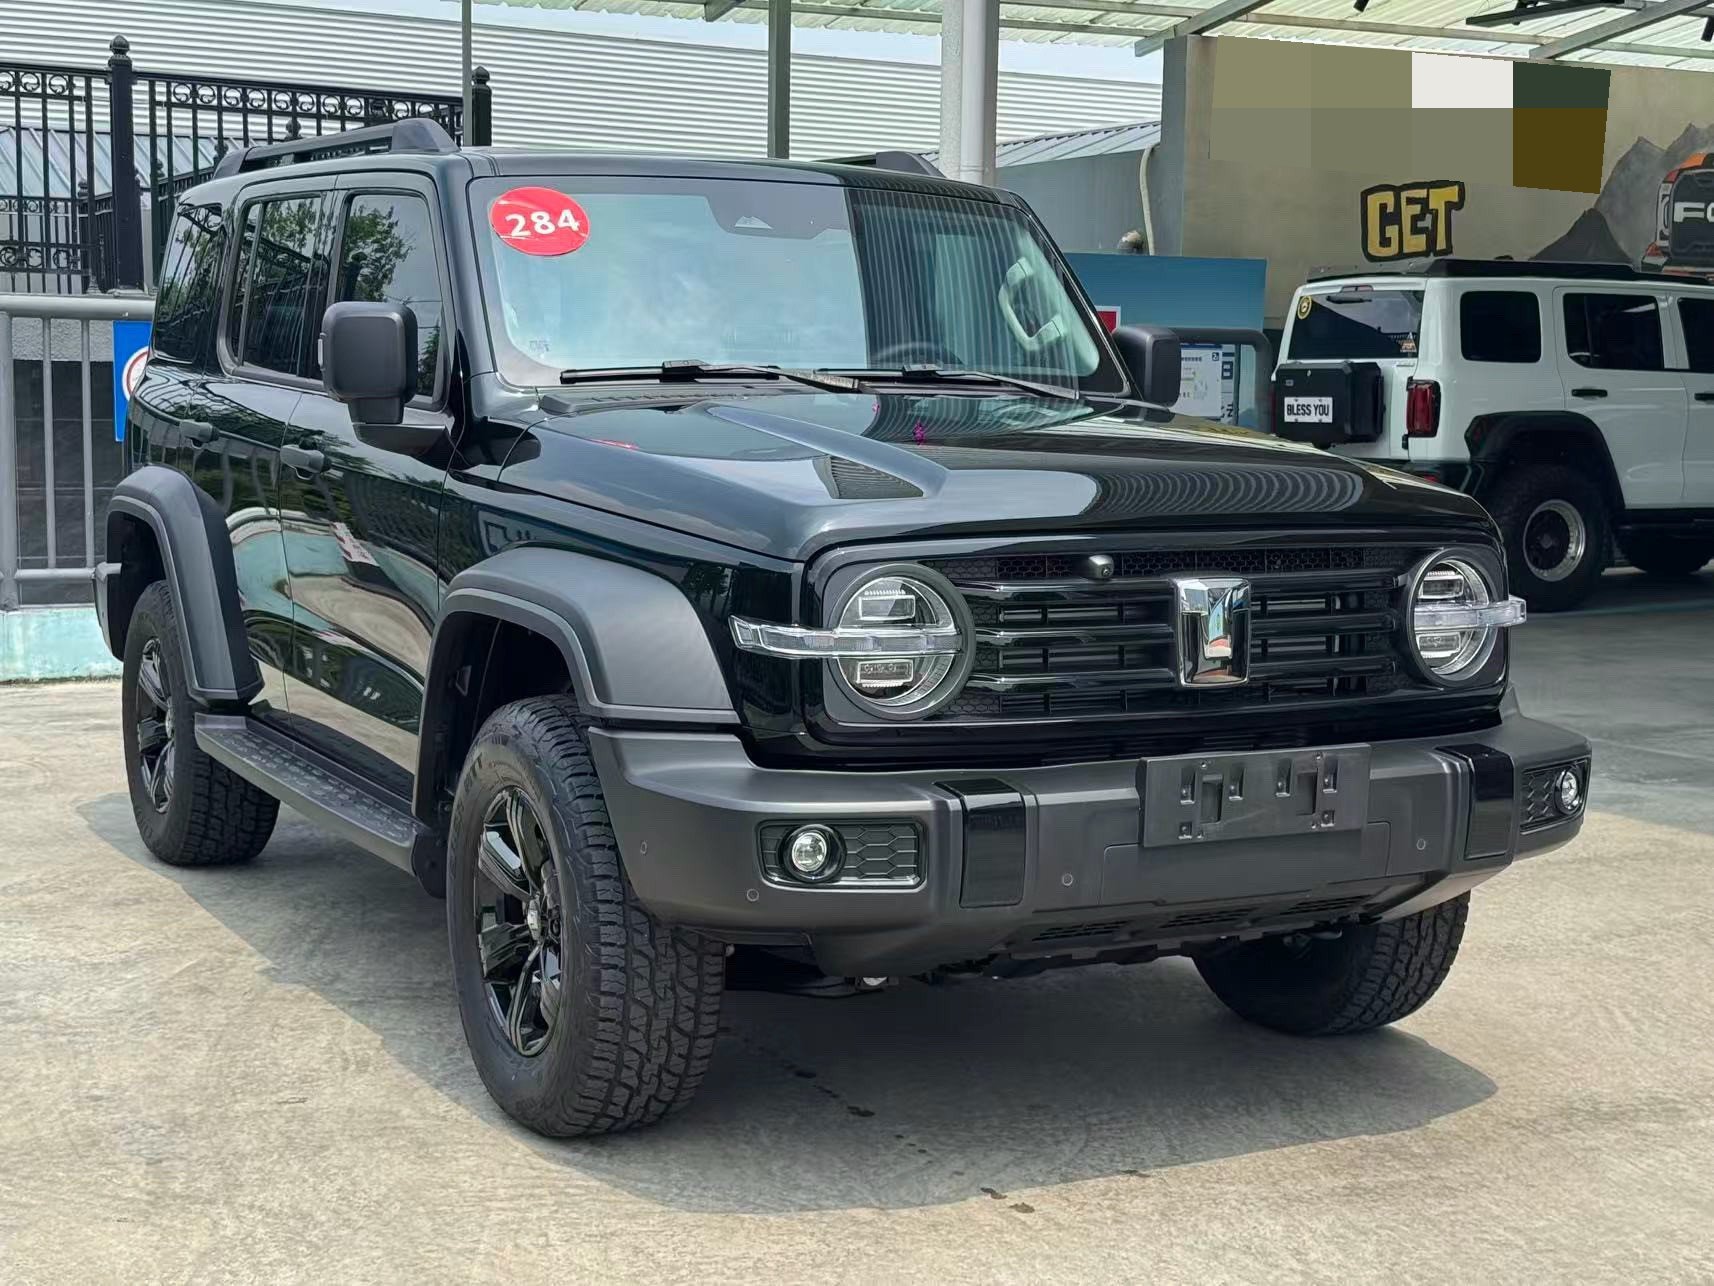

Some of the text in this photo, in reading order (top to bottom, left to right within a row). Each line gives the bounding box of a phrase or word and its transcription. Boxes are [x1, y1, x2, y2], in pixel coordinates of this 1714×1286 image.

[505, 208, 580, 237] 284
[1363, 182, 1463, 260] GET
[1286, 404, 1329, 416] BLESS YOU
